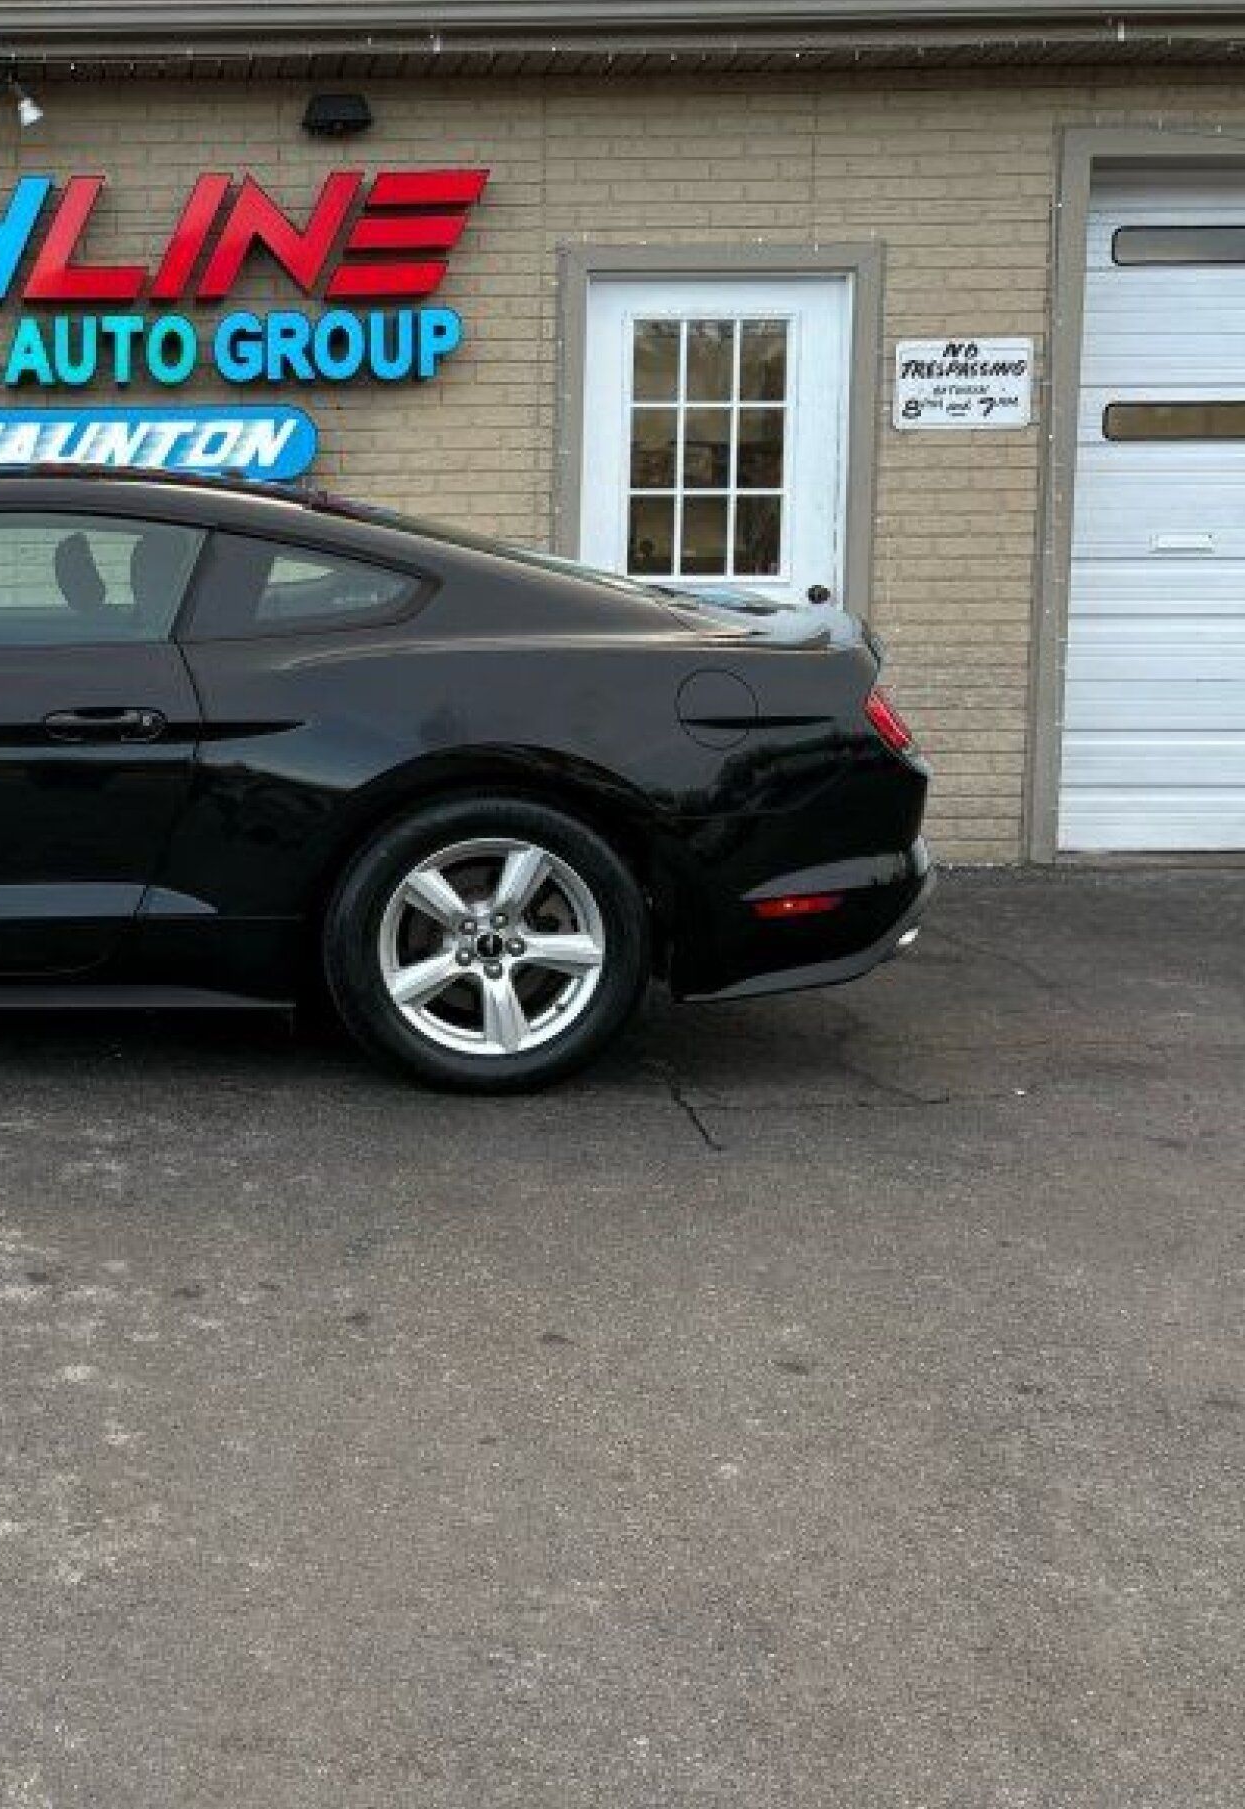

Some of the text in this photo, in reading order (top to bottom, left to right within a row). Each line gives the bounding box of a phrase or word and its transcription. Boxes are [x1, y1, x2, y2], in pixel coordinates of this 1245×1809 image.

[5, 307, 464, 386] AUTO GROUP
[943, 342, 978, 358] NO
[901, 360, 1027, 379] TRESPASSING
